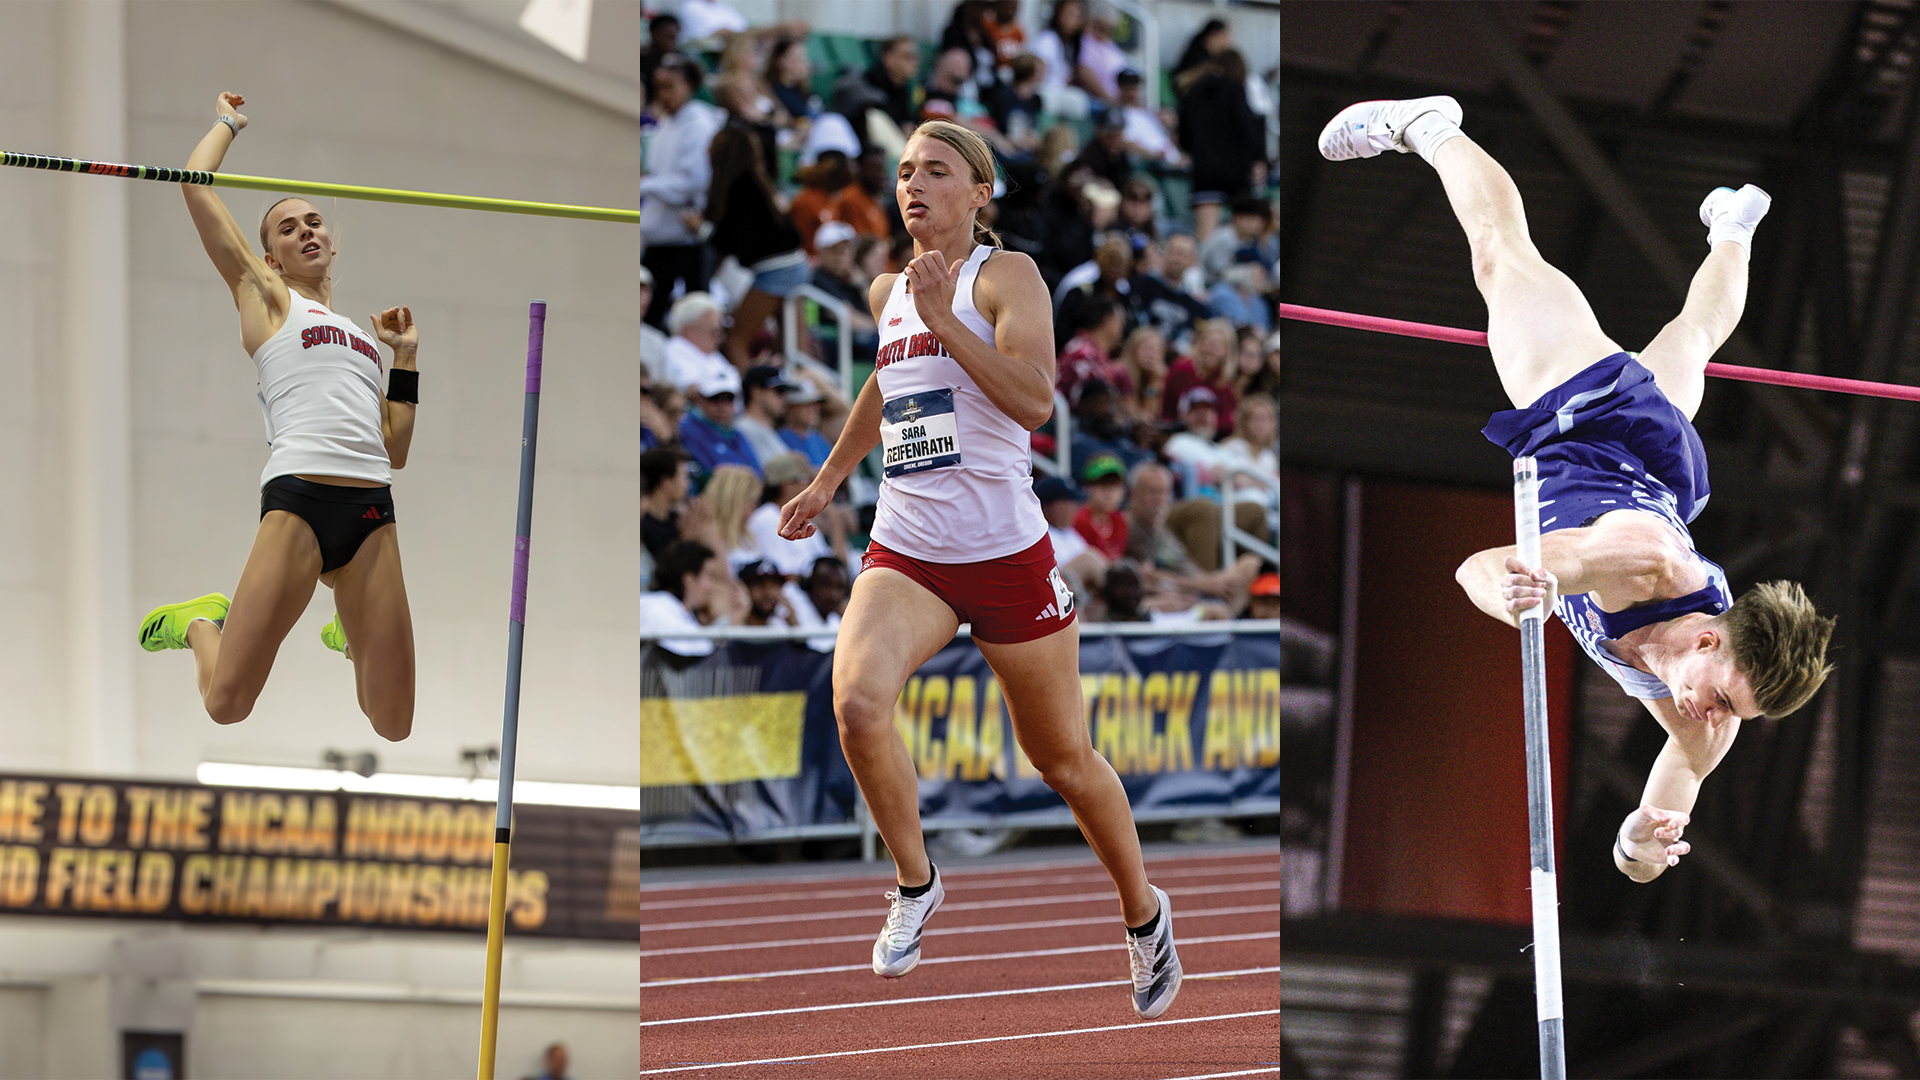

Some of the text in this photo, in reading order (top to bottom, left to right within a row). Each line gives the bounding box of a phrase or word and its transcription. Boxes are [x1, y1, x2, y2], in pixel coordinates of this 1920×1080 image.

[88, 162, 129, 176] GILL
[301, 325, 383, 374] SOUTH DAKOT
[908, 331, 952, 358] DAKO
[886, 435, 954, 464] REIFENRATH
[901, 424, 927, 441] SARA
[1203, 667, 1280, 772] AND
[55, 782, 117, 847] TO
[124, 786, 214, 850] THE
[218, 791, 338, 858] NCAA
[45, 846, 175, 914] FIELD
